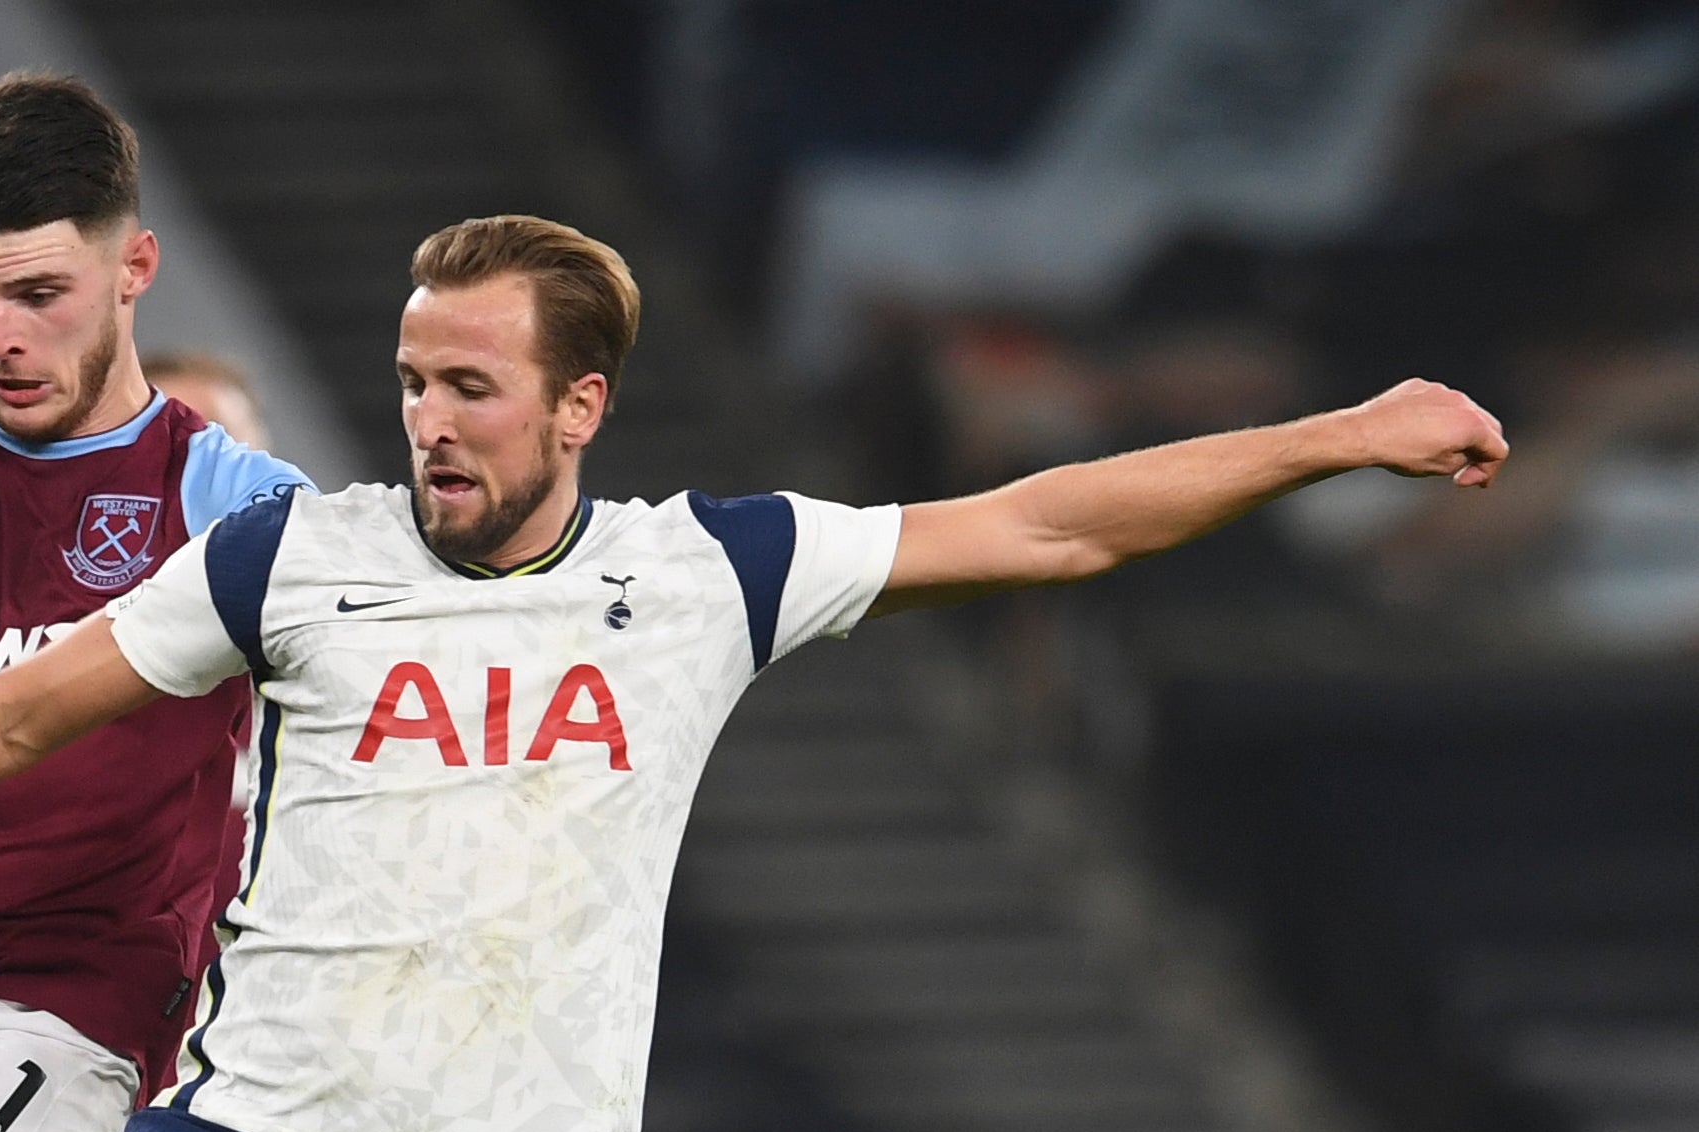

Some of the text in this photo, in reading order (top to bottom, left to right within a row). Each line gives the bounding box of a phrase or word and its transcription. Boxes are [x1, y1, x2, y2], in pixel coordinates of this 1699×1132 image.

[92, 499, 150, 512] WEST HAM
[102, 508, 137, 517] UNITED
[97, 574, 126, 585] YEARS
[351, 661, 633, 771] AIA
